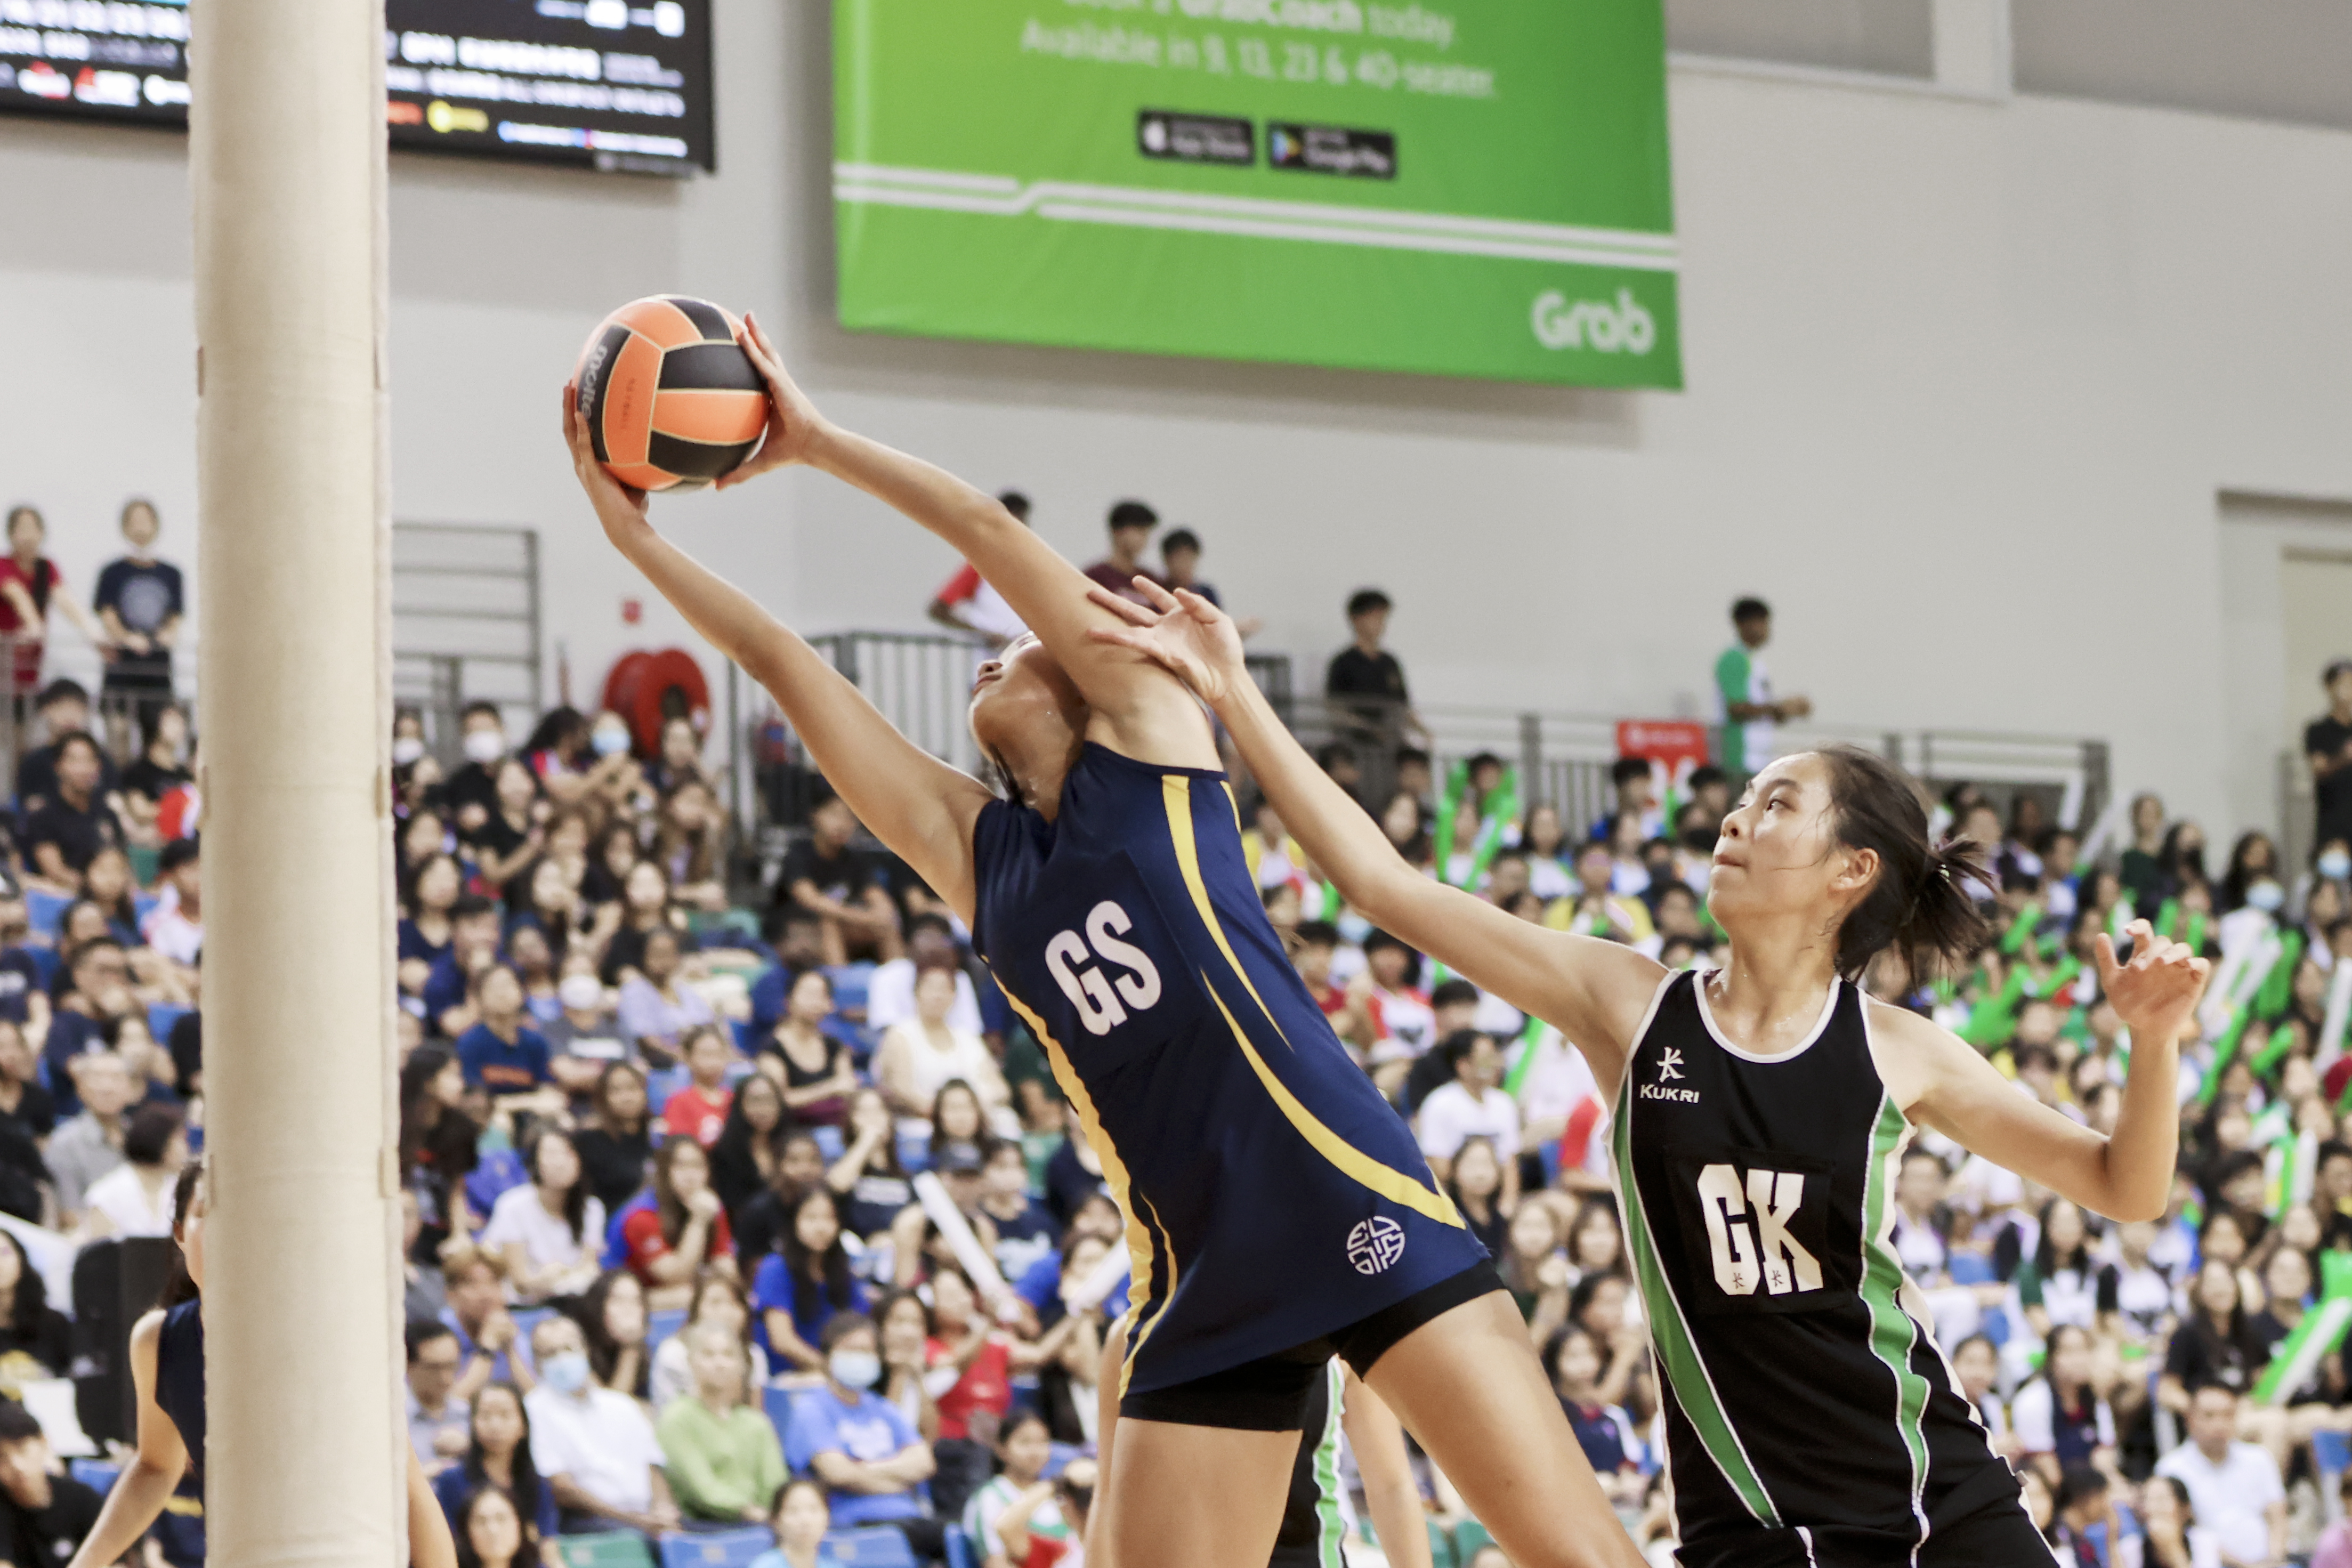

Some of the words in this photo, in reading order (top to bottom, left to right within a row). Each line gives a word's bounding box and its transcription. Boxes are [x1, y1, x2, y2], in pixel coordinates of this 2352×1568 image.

[1530, 288, 1655, 355] Grab
[1045, 900, 1162, 1036] GS
[1640, 1084, 1699, 1103] KUKRI
[1697, 1164, 1824, 1295] GK
